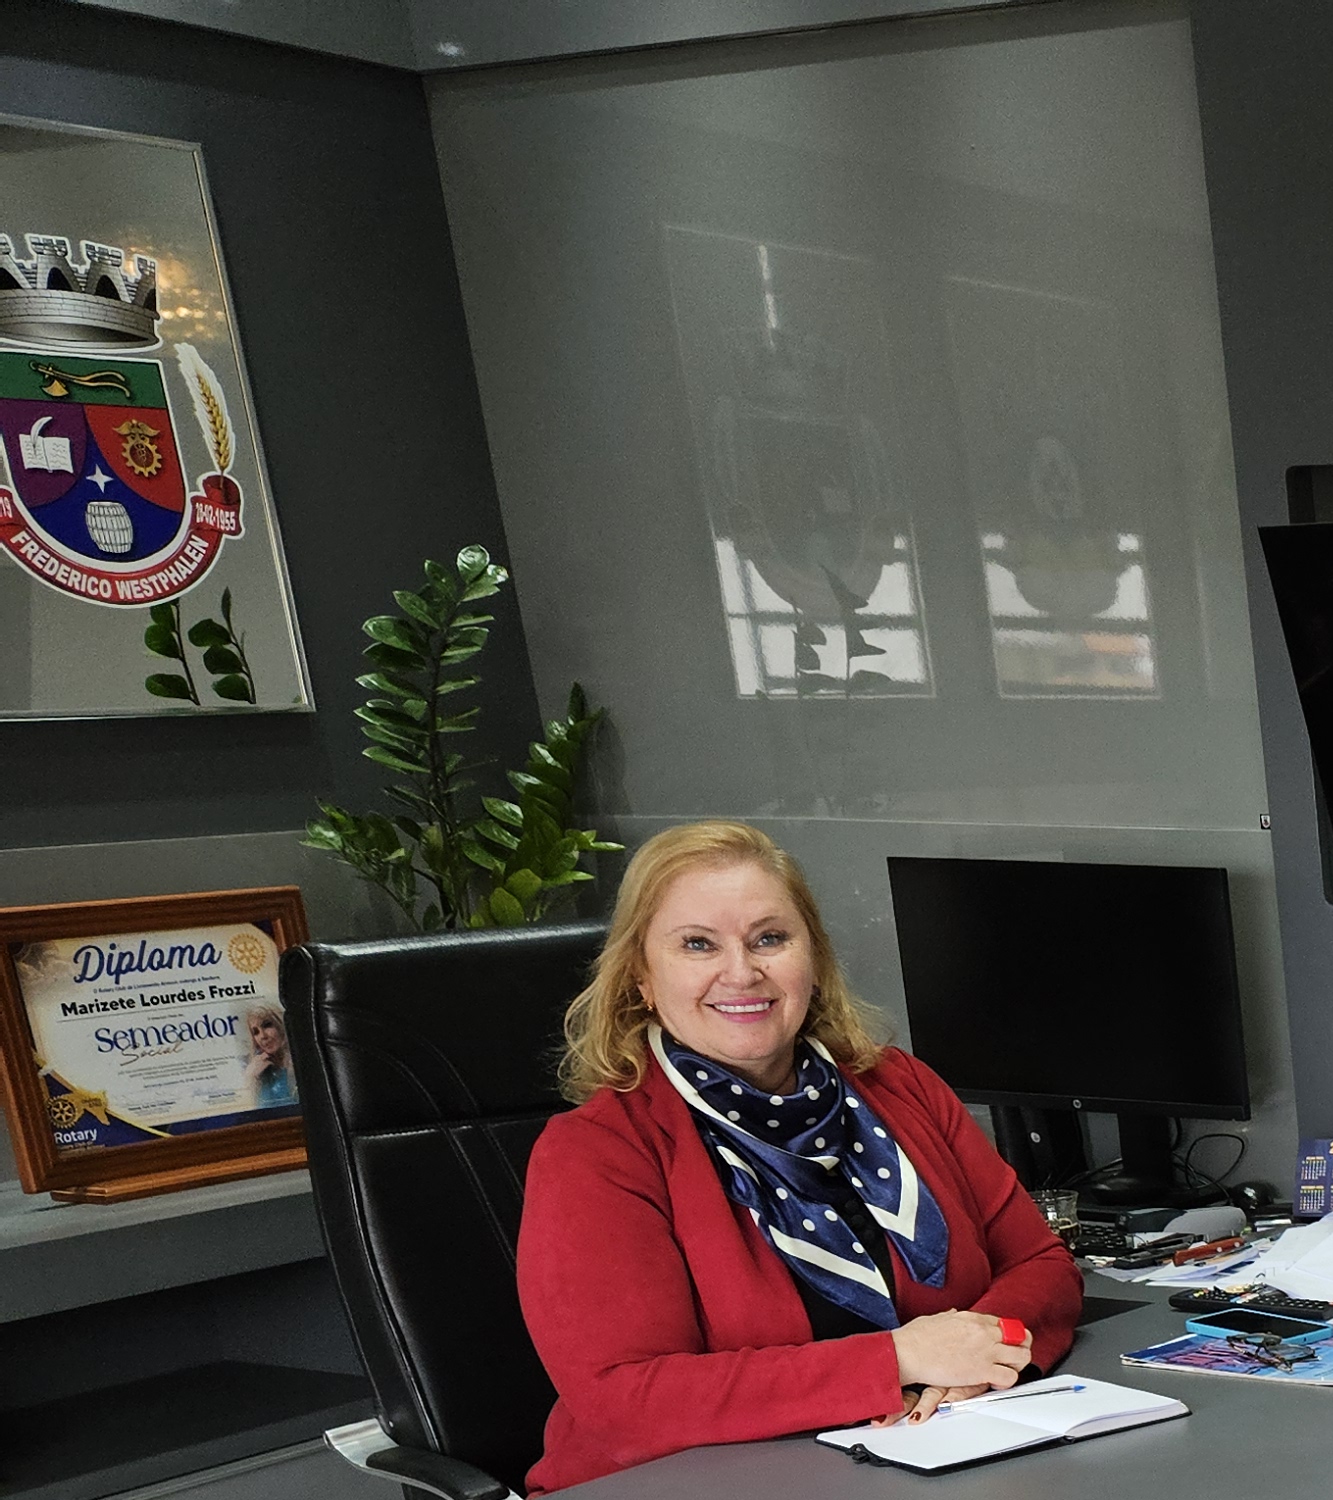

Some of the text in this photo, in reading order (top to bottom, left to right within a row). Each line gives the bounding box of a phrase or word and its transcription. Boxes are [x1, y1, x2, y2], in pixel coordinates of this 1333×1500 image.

[10, 530, 210, 600] FREDERICO WESTPHALEN
[73, 940, 222, 985] Diploma
[61, 995, 136, 1017] Marizete
[140, 989, 205, 1008] Lourdes
[209, 980, 256, 999] Frozzi
[94, 1014, 239, 1053] Semeador
[53, 1128, 98, 1145] Rotary
